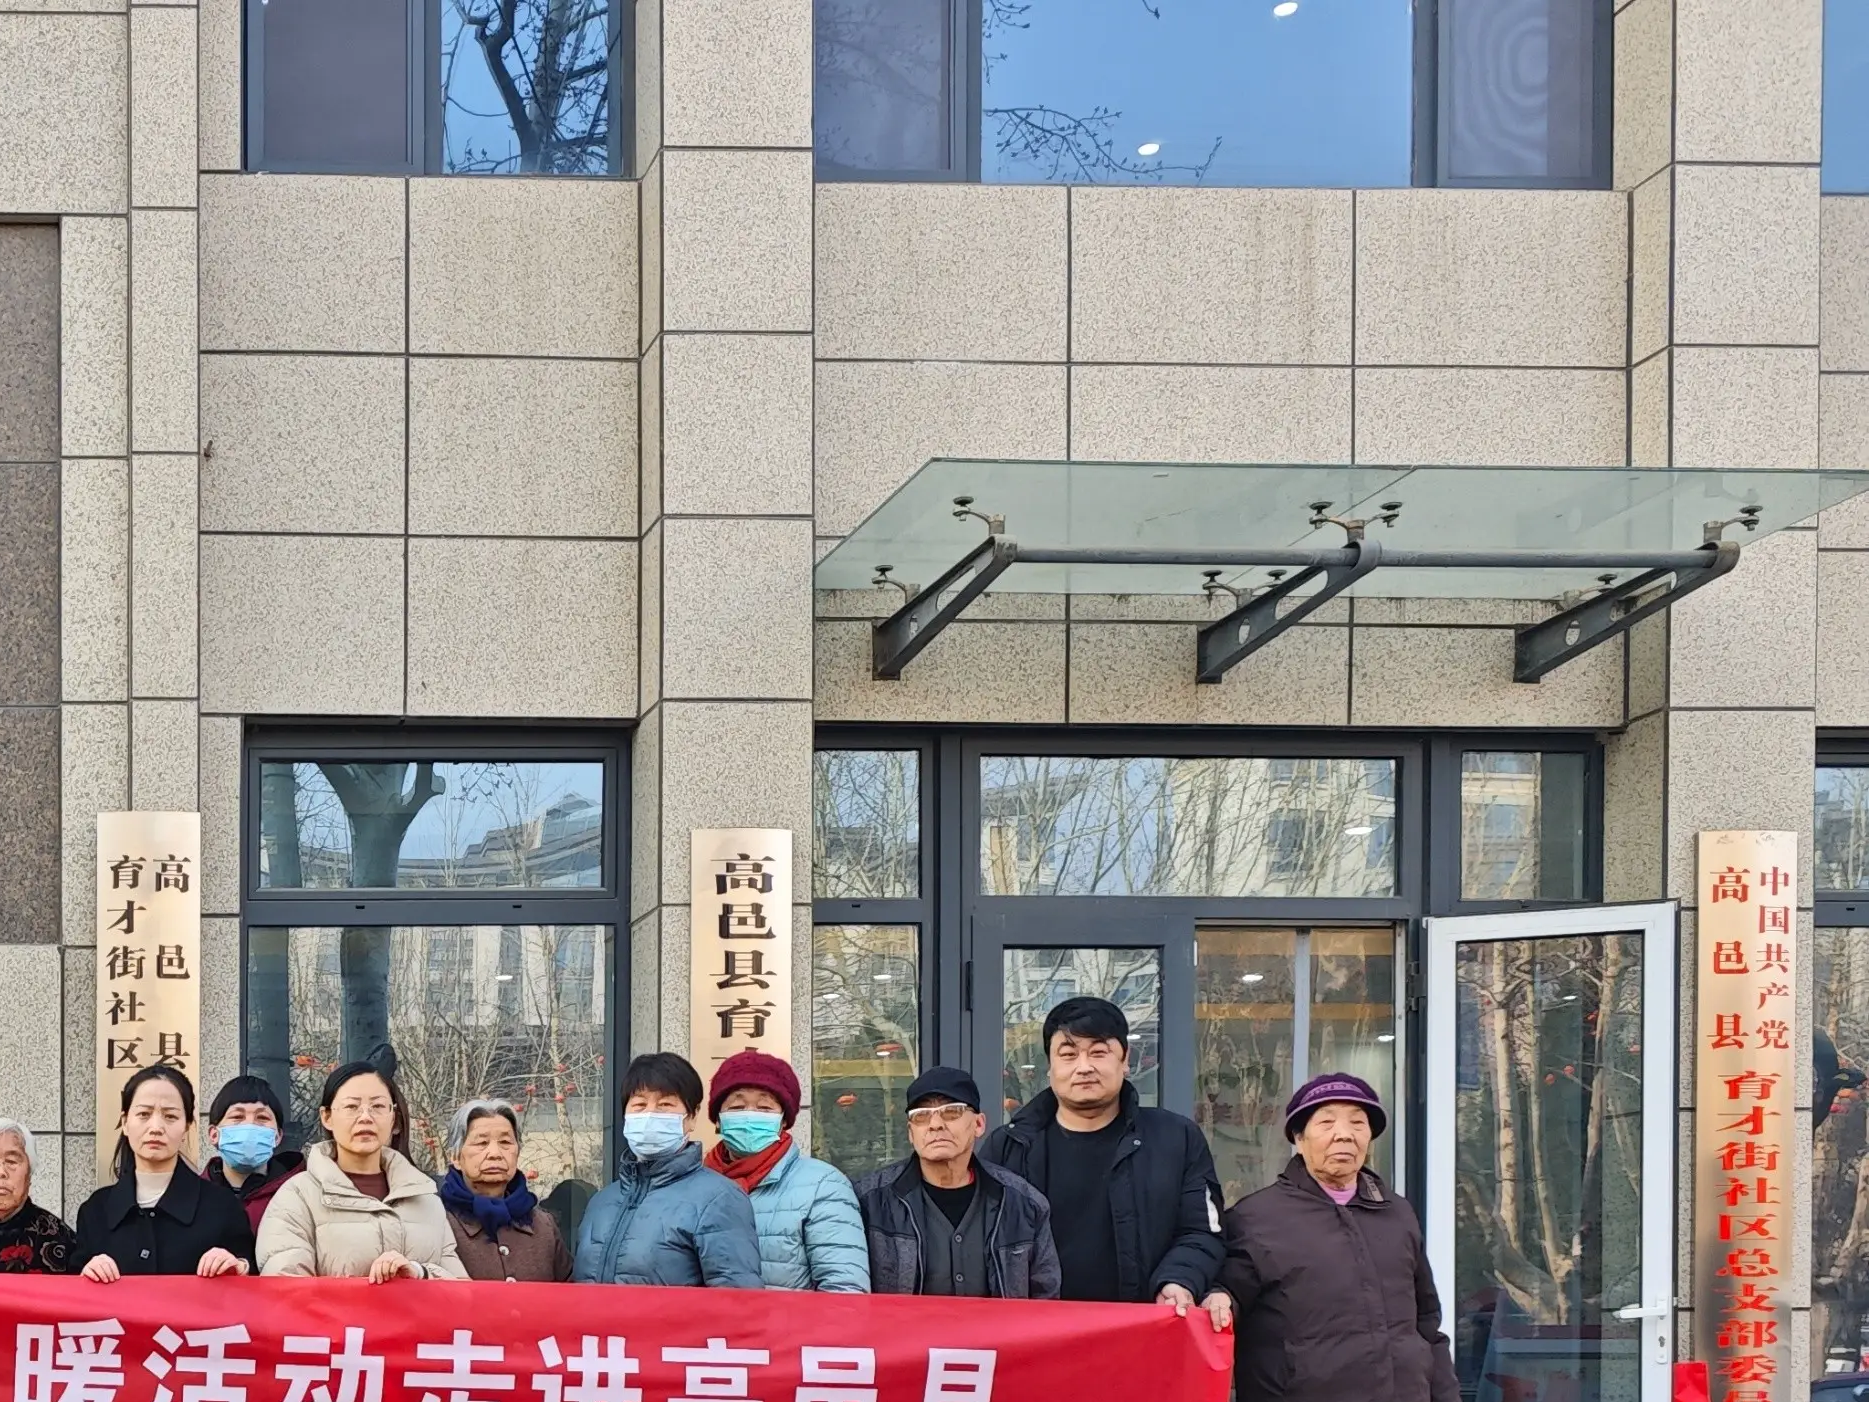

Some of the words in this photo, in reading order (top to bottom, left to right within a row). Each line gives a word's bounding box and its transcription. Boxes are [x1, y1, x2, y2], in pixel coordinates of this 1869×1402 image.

[105, 854, 147, 1071] 育才街社区
[150, 854, 191, 1069] 高邑县
[710, 853, 777, 1060] 高邑县育
[1709, 865, 1750, 1051] 高邑县
[1756, 866, 1790, 1051] 中国共产党
